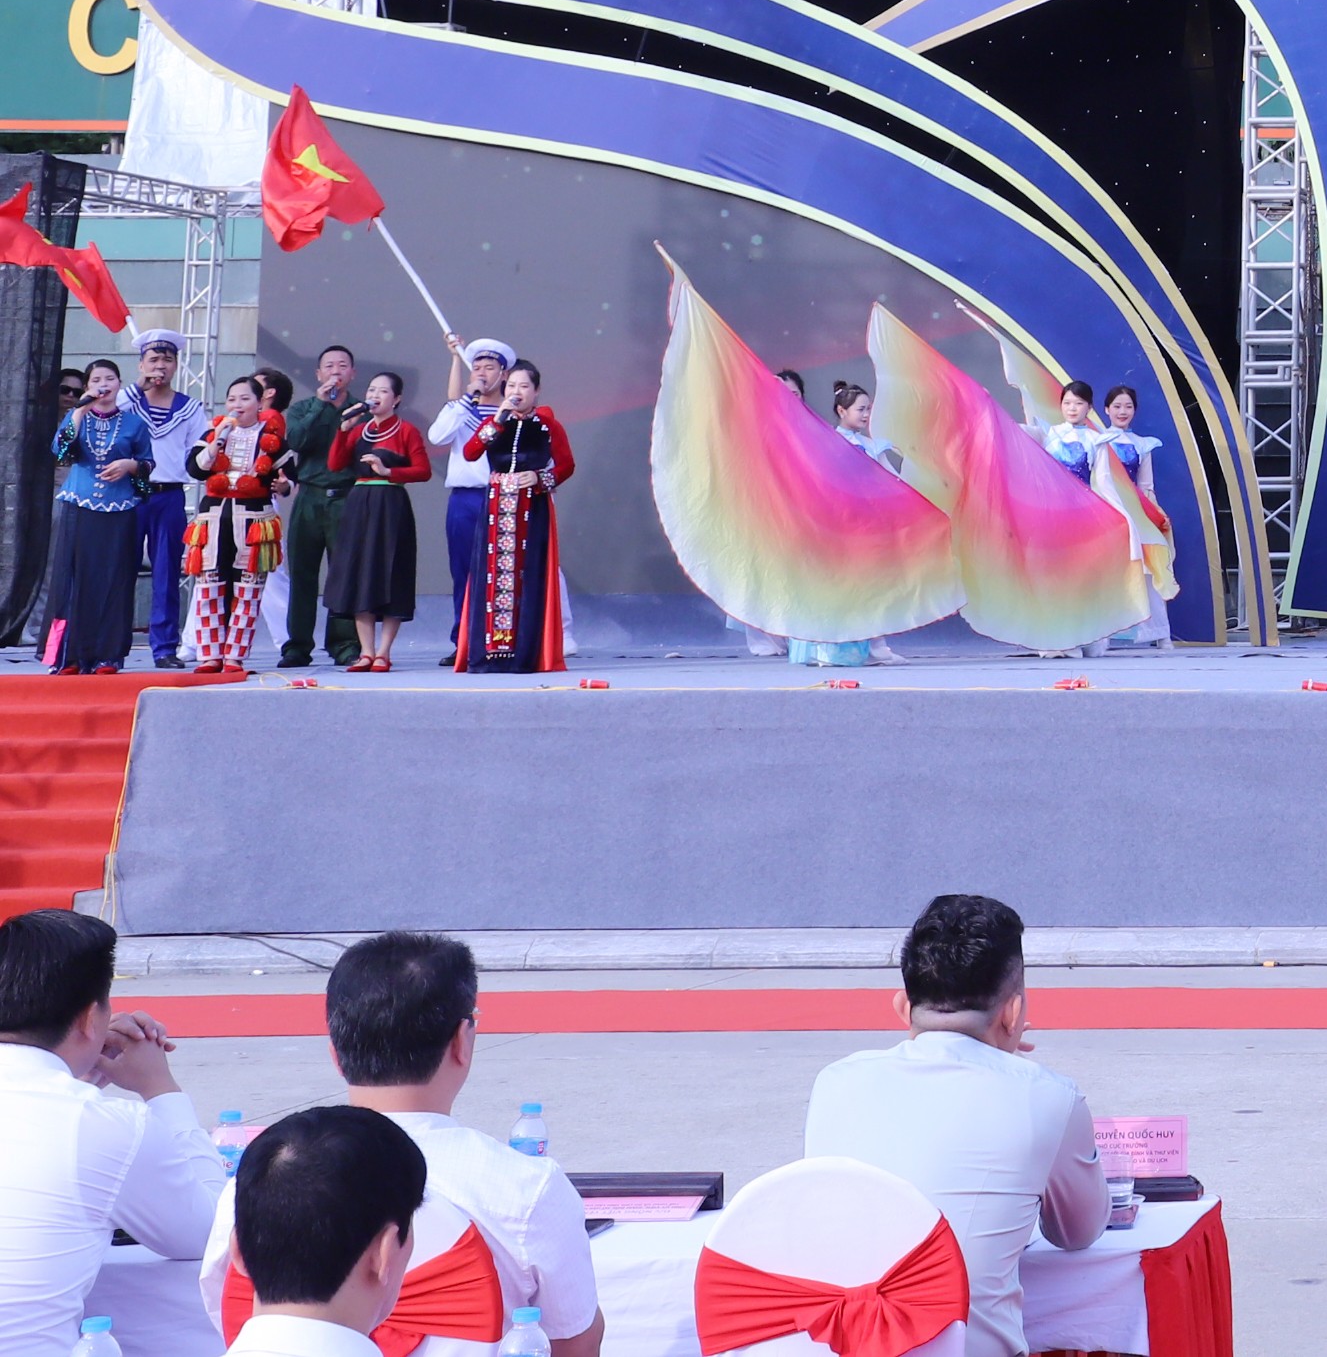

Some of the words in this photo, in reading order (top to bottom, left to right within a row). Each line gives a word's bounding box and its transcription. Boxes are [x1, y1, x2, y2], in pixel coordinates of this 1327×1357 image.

[1095, 1128, 1125, 1140] GUYỄN
[1127, 1128, 1154, 1140] QUỐC
[1156, 1130, 1175, 1139] HUY
